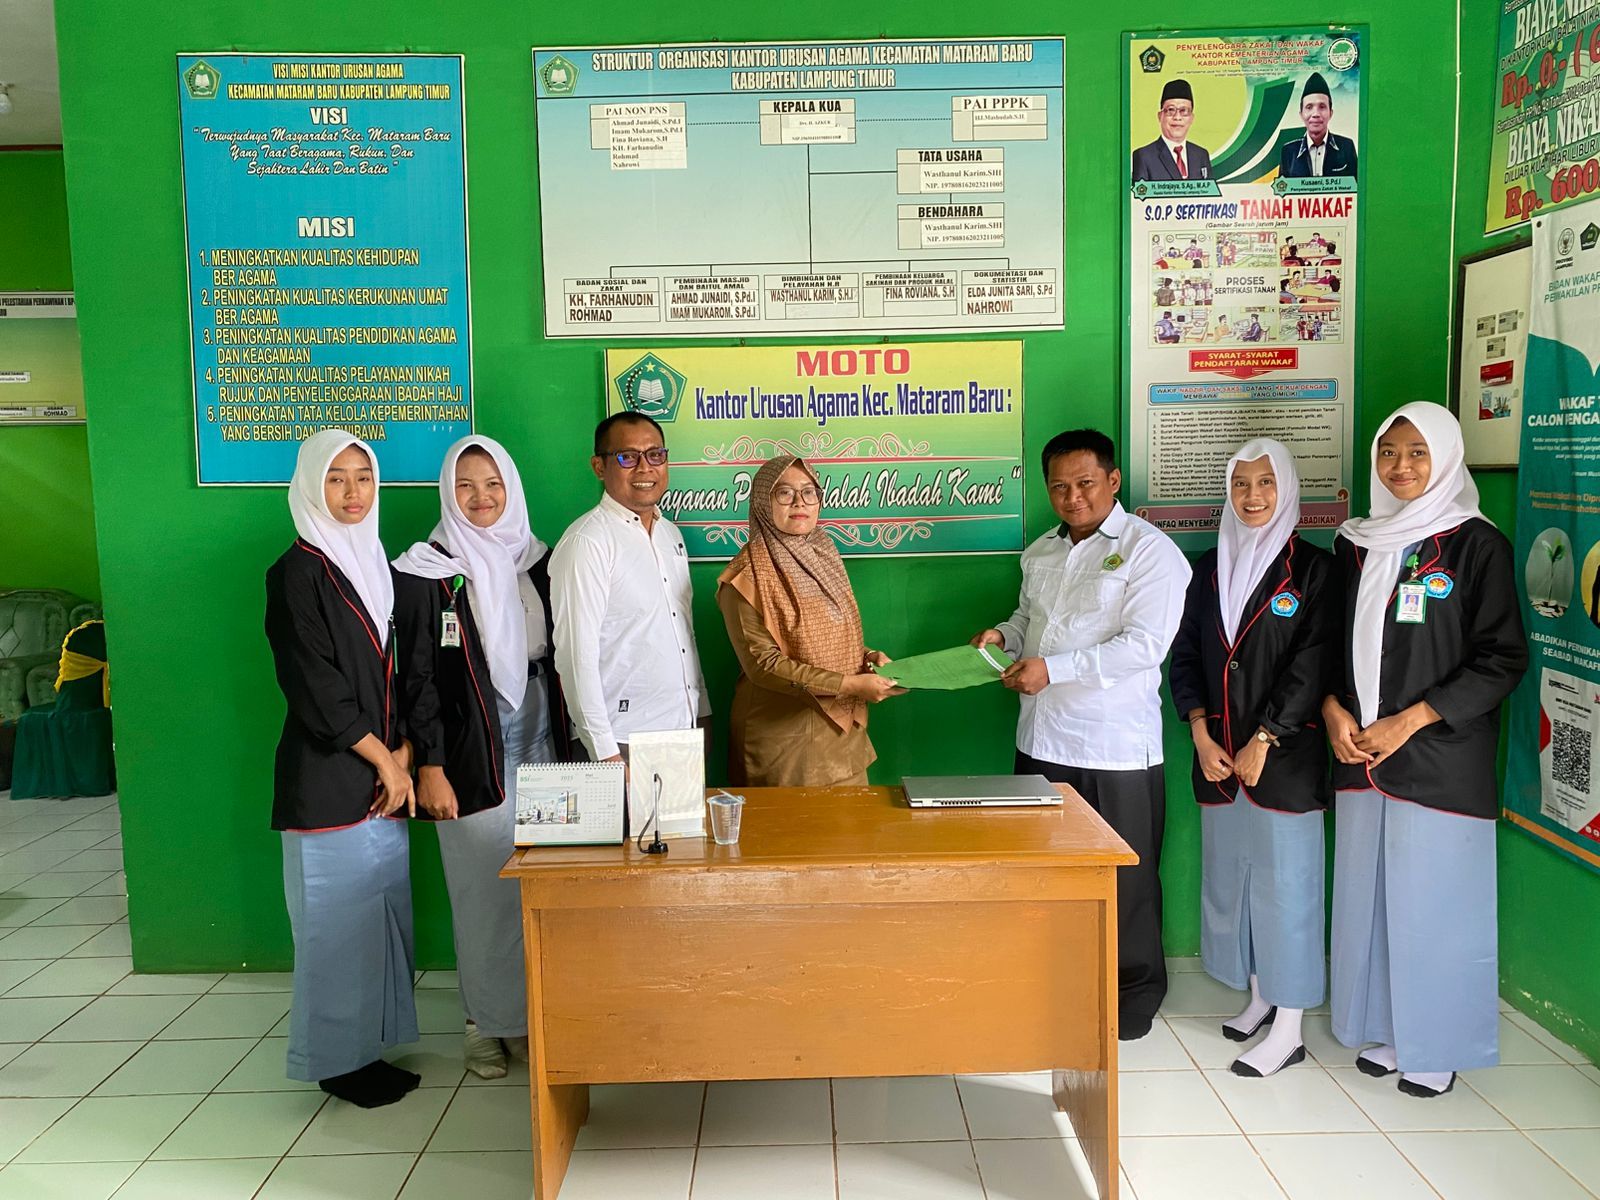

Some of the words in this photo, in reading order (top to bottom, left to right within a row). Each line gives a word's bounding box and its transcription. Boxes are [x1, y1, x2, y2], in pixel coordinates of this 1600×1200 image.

[1177, 43, 1246, 51] PENYELENGGARA
[1226, 50, 1281, 58] KEMENTERIAN
[592, 52, 654, 71] STRUKTUR
[658, 50, 729, 69] ORGANISASI
[731, 49, 777, 68] KANTOR
[780, 48, 826, 66] URUSAN
[829, 48, 870, 65] AGAMA
[872, 46, 941, 65] KECAMATAN
[943, 44, 999, 63] MATARAM
[1001, 44, 1033, 62] BARU
[273, 64, 289, 79] VISI
[290, 64, 308, 79] MISI
[310, 64, 341, 79] KANTOR
[343, 64, 373, 79] URUSAN
[376, 64, 403, 79] AGAMA
[731, 71, 798, 90] KABUPATEN
[800, 70, 856, 89] LAMPUNG
[858, 69, 895, 87] TIMUR
[228, 85, 274, 100] KECAMATAN
[277, 85, 315, 100] MATARAM
[317, 85, 338, 100] BARU
[340, 85, 384, 100] KABUPATEN
[386, 85, 423, 100] LAMPUNG
[425, 85, 450, 100] TIMUR
[1501, 71, 1533, 109] Rp.
[625, 107, 646, 115] NON
[649, 106, 667, 114] PNS
[774, 101, 815, 112] KEPALA
[819, 101, 841, 111] KUA
[964, 99, 987, 109] PAI
[993, 98, 1028, 108] PPPK
[310, 107, 348, 125] VISI
[271, 128, 339, 143] Masyarakat
[367, 128, 420, 141] Mataram
[423, 128, 450, 141] Baru
[1507, 116, 1550, 169] BIAYA
[229, 145, 257, 160] Yang
[261, 145, 289, 158] Taat
[391, 147, 413, 158] Dan
[918, 151, 942, 162] TATA
[946, 150, 982, 161] USAHA
[247, 161, 298, 178] Sejahtera
[300, 162, 330, 175] Lahir
[333, 162, 356, 175] Dan
[1145, 205, 1173, 221] S.O.P
[1175, 204, 1238, 220] SERTIFIKASI
[1240, 199, 1293, 220] TANAH
[1297, 197, 1353, 218] WAKAF
[1505, 186, 1543, 220] Rp.
[918, 206, 983, 217] BENDAHARA
[298, 217, 355, 237] MISI
[211, 250, 298, 266] MENINGKATKAN
[301, 250, 354, 266] KUALITAS
[356, 250, 419, 266] KEHIDUPAN
[214, 270, 236, 286] BER
[238, 270, 277, 286] AGAMA
[1226, 277, 1265, 285] PROSES
[214, 289, 290, 305] PENINGKATAN
[292, 289, 345, 305] KUALITAS
[348, 289, 416, 305] KERUKUNAN
[418, 288, 448, 304] UMAT
[771, 289, 811, 302] WASTHANUL
[886, 287, 903, 299] FINA
[967, 287, 986, 298] ELDA
[987, 286, 1014, 297] JUNITA
[1255, 286, 1276, 294] TANAH
[589, 293, 653, 306] FARHANUDIN
[671, 292, 698, 304] AHMAD
[570, 309, 612, 322] ROHMAD
[967, 301, 1013, 315] NAHROWI
[216, 309, 238, 325] BER
[240, 309, 279, 324] AGAMA
[216, 328, 292, 344] PENINGKATAN
[294, 328, 346, 344] KUALITAS
[349, 328, 415, 344] PENDIDIKAN
[418, 328, 456, 344] AGAMA
[218, 348, 240, 364] DAN
[242, 348, 311, 364] KEAGAMAAN
[796, 348, 910, 376] MOTO
[1194, 360, 1259, 368] PENDAFTARAN
[1260, 358, 1293, 366] WAKAF
[217, 367, 293, 383] PENINGKATAN
[296, 367, 348, 382] KUALITAS
[350, 366, 413, 382] PELAYANAN
[416, 366, 450, 382] NIKAH
[220, 386, 256, 403] RUJUK
[258, 386, 280, 402] DAN
[283, 386, 392, 402] PENYELENGGARAAN
[395, 386, 434, 402] IBADAH
[438, 386, 462, 402] HAJI
[695, 387, 748, 420] Kantor
[750, 387, 804, 419] Urusan
[807, 386, 858, 426] Agama
[862, 384, 893, 416] Kec.
[896, 383, 964, 414] Mataram
[220, 406, 295, 422] PENINGKATAN
[298, 406, 322, 421] TATA
[326, 406, 368, 422] KELOLA
[370, 405, 468, 421] KEPEMERINTAHAN
[1528, 413, 1563, 426] CALON
[221, 425, 250, 441] YANG
[253, 425, 292, 441] BERSIH
[1530, 632, 1566, 648] ABADIKAN
